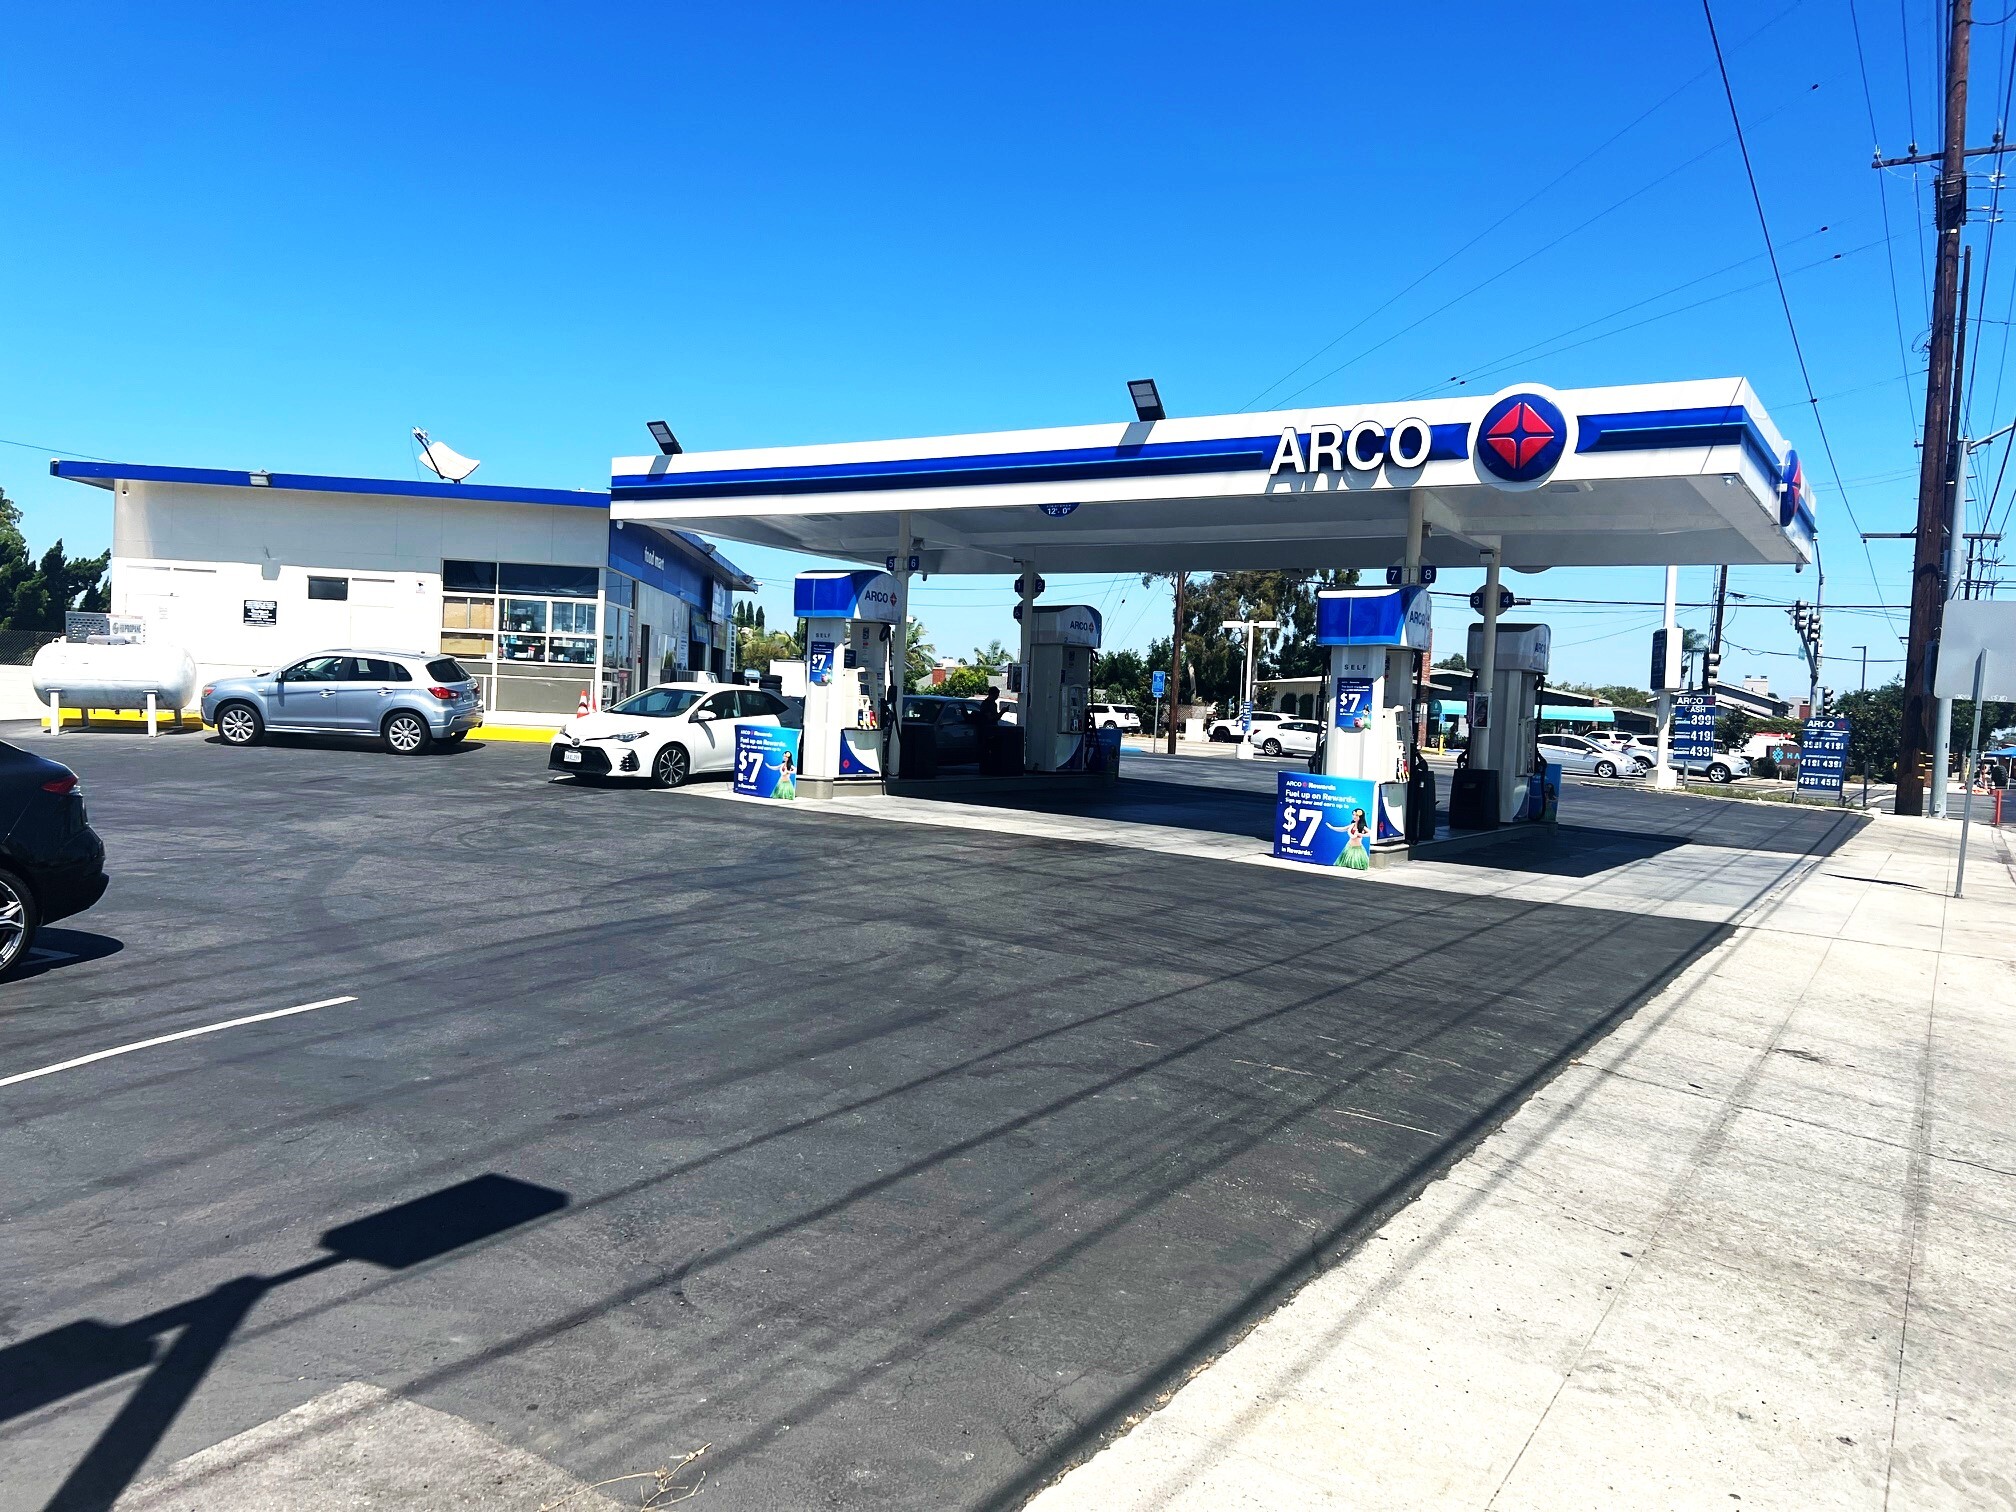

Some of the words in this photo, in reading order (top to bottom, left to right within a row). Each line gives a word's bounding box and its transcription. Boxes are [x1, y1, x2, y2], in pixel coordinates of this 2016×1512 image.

[1270, 417, 1432, 474] ARCO
[645, 546, 654, 565] food
[655, 556, 664, 570] mart
[888, 560, 893, 568] 5
[912, 559, 916, 568] 6
[1391, 570, 1397, 580] 7
[1425, 570, 1432, 579] 8
[865, 590, 888, 603] ARCO
[1473, 596, 1479, 604] 3
[1504, 596, 1509, 604] 4
[1409, 611, 1425, 626] ARCO
[1070, 620, 1087, 630] ARCO
[812, 654, 826, 670] $7
[1340, 693, 1360, 712] $7
[1807, 720, 1835, 728] ARCO
[739, 750, 763, 782] $7
[1308, 782, 1336, 790] Rewards
[1283, 805, 1322, 847] $7
